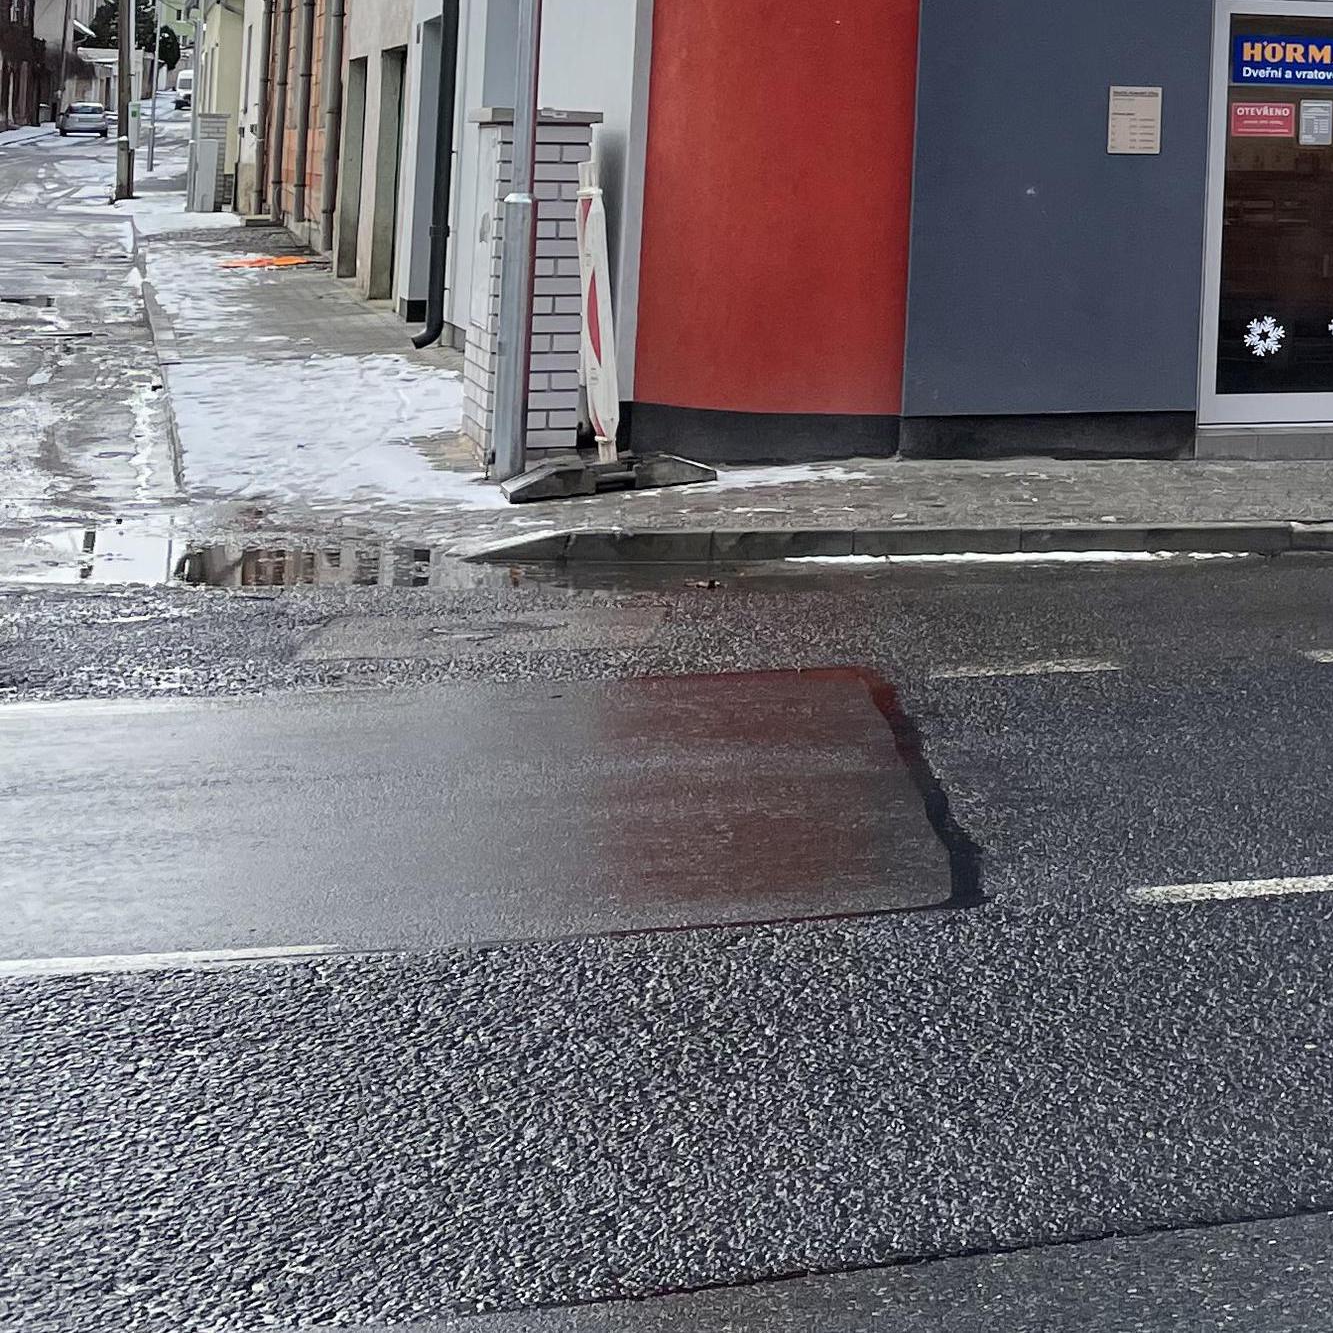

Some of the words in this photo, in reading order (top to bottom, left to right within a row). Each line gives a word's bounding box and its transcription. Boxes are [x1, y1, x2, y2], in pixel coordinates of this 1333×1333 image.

[1242, 66, 1282, 78] Dveřní
[1284, 70, 1292, 78] a
[1236, 106, 1290, 116] OTEVŘENO
